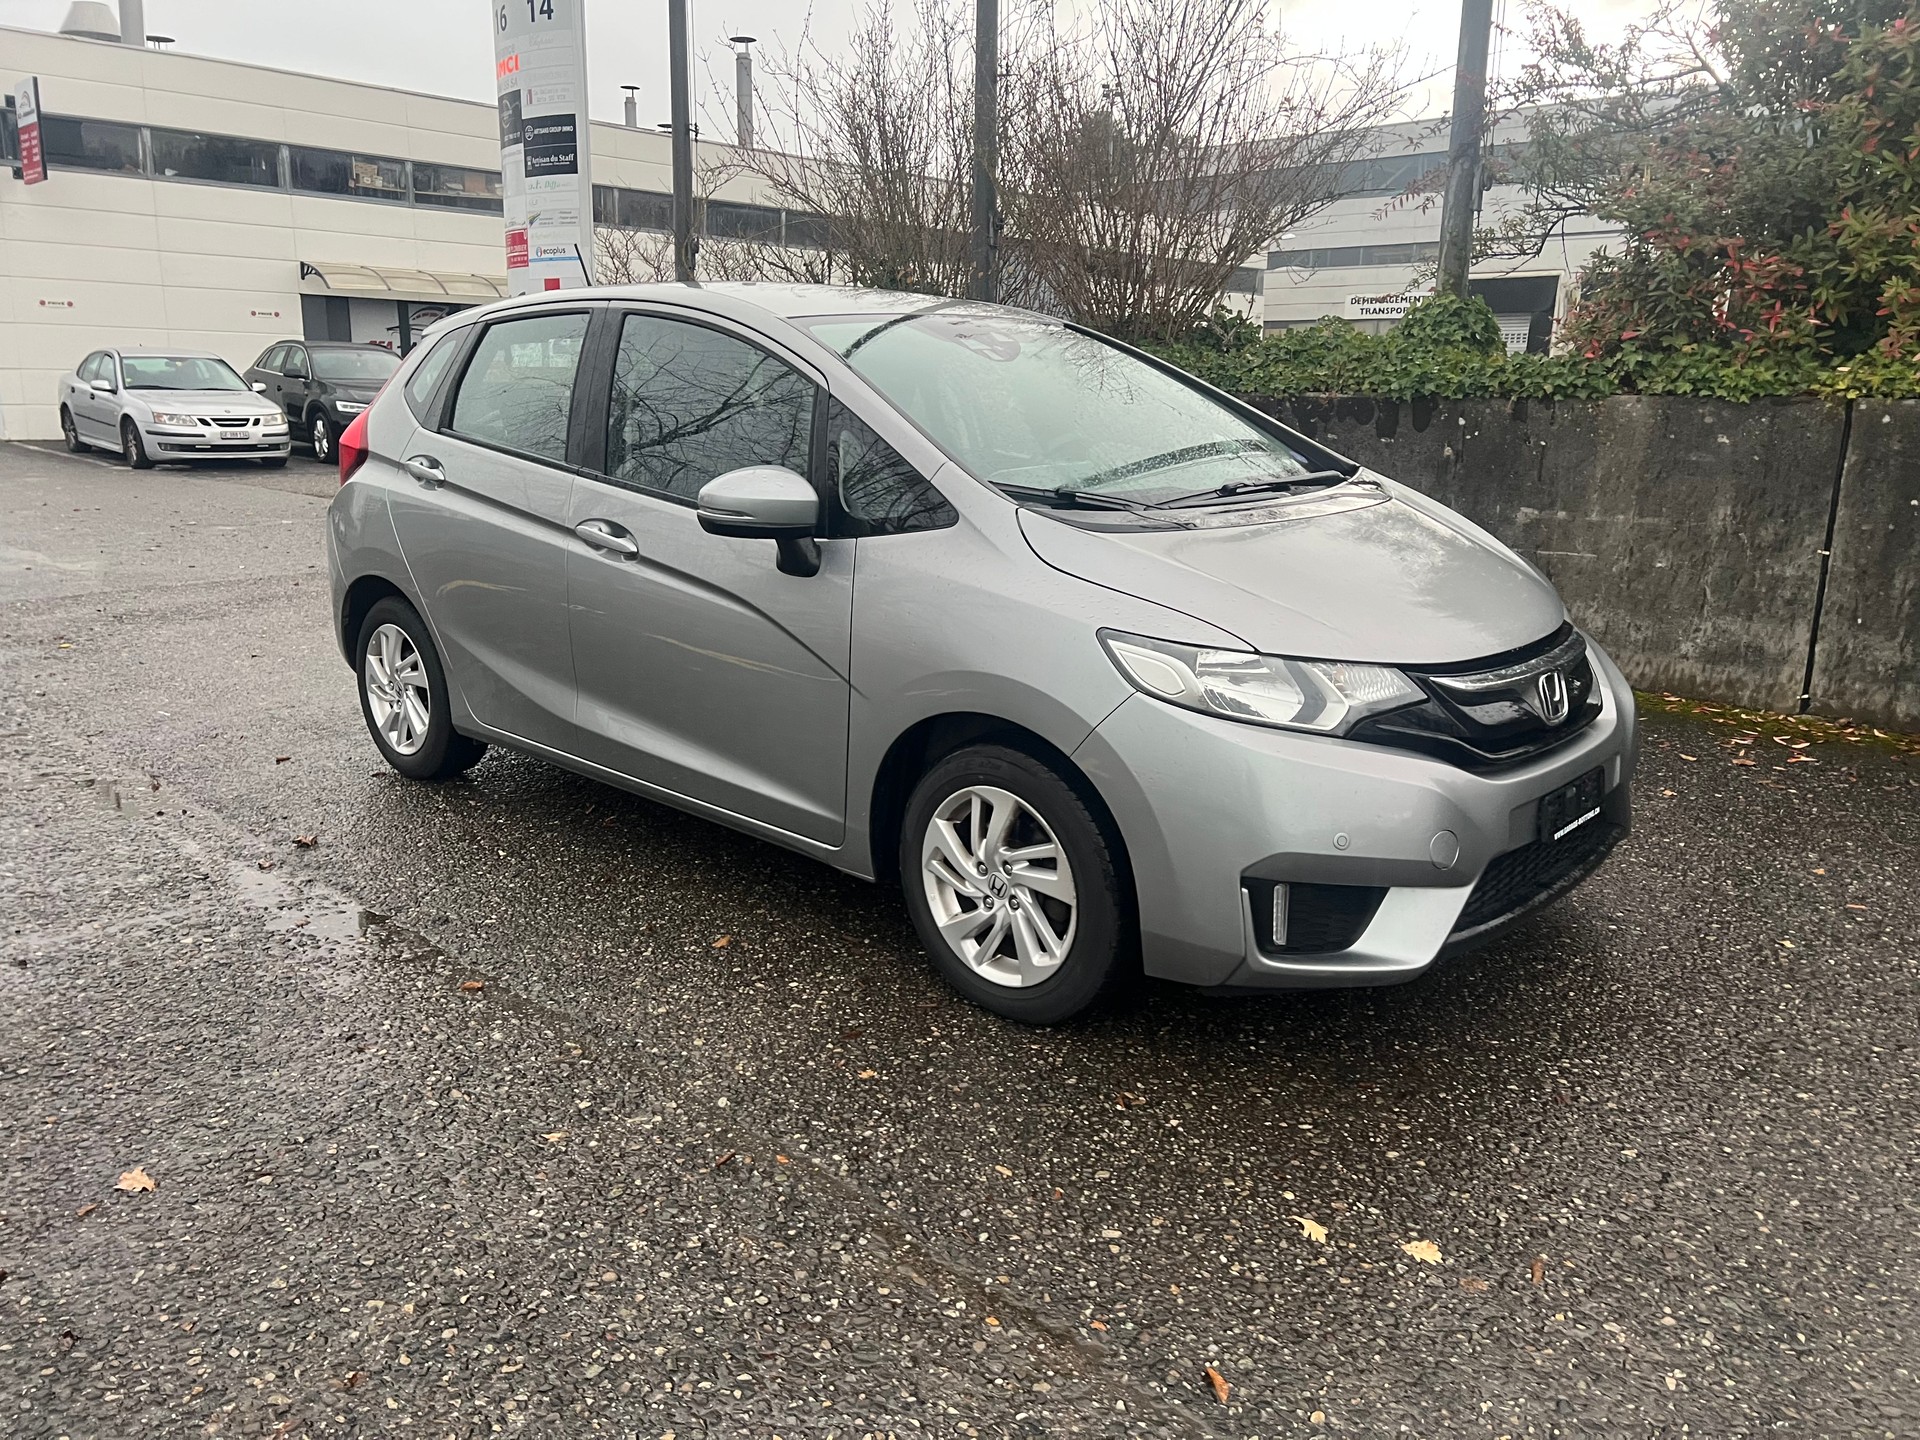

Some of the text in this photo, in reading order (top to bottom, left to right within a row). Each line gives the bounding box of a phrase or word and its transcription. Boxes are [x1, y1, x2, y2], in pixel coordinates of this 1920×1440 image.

[527, 0, 554, 22] 14
[495, 4, 507, 35] 16
[560, 154, 574, 162] Staff
[543, 247, 566, 255] ecoplus
